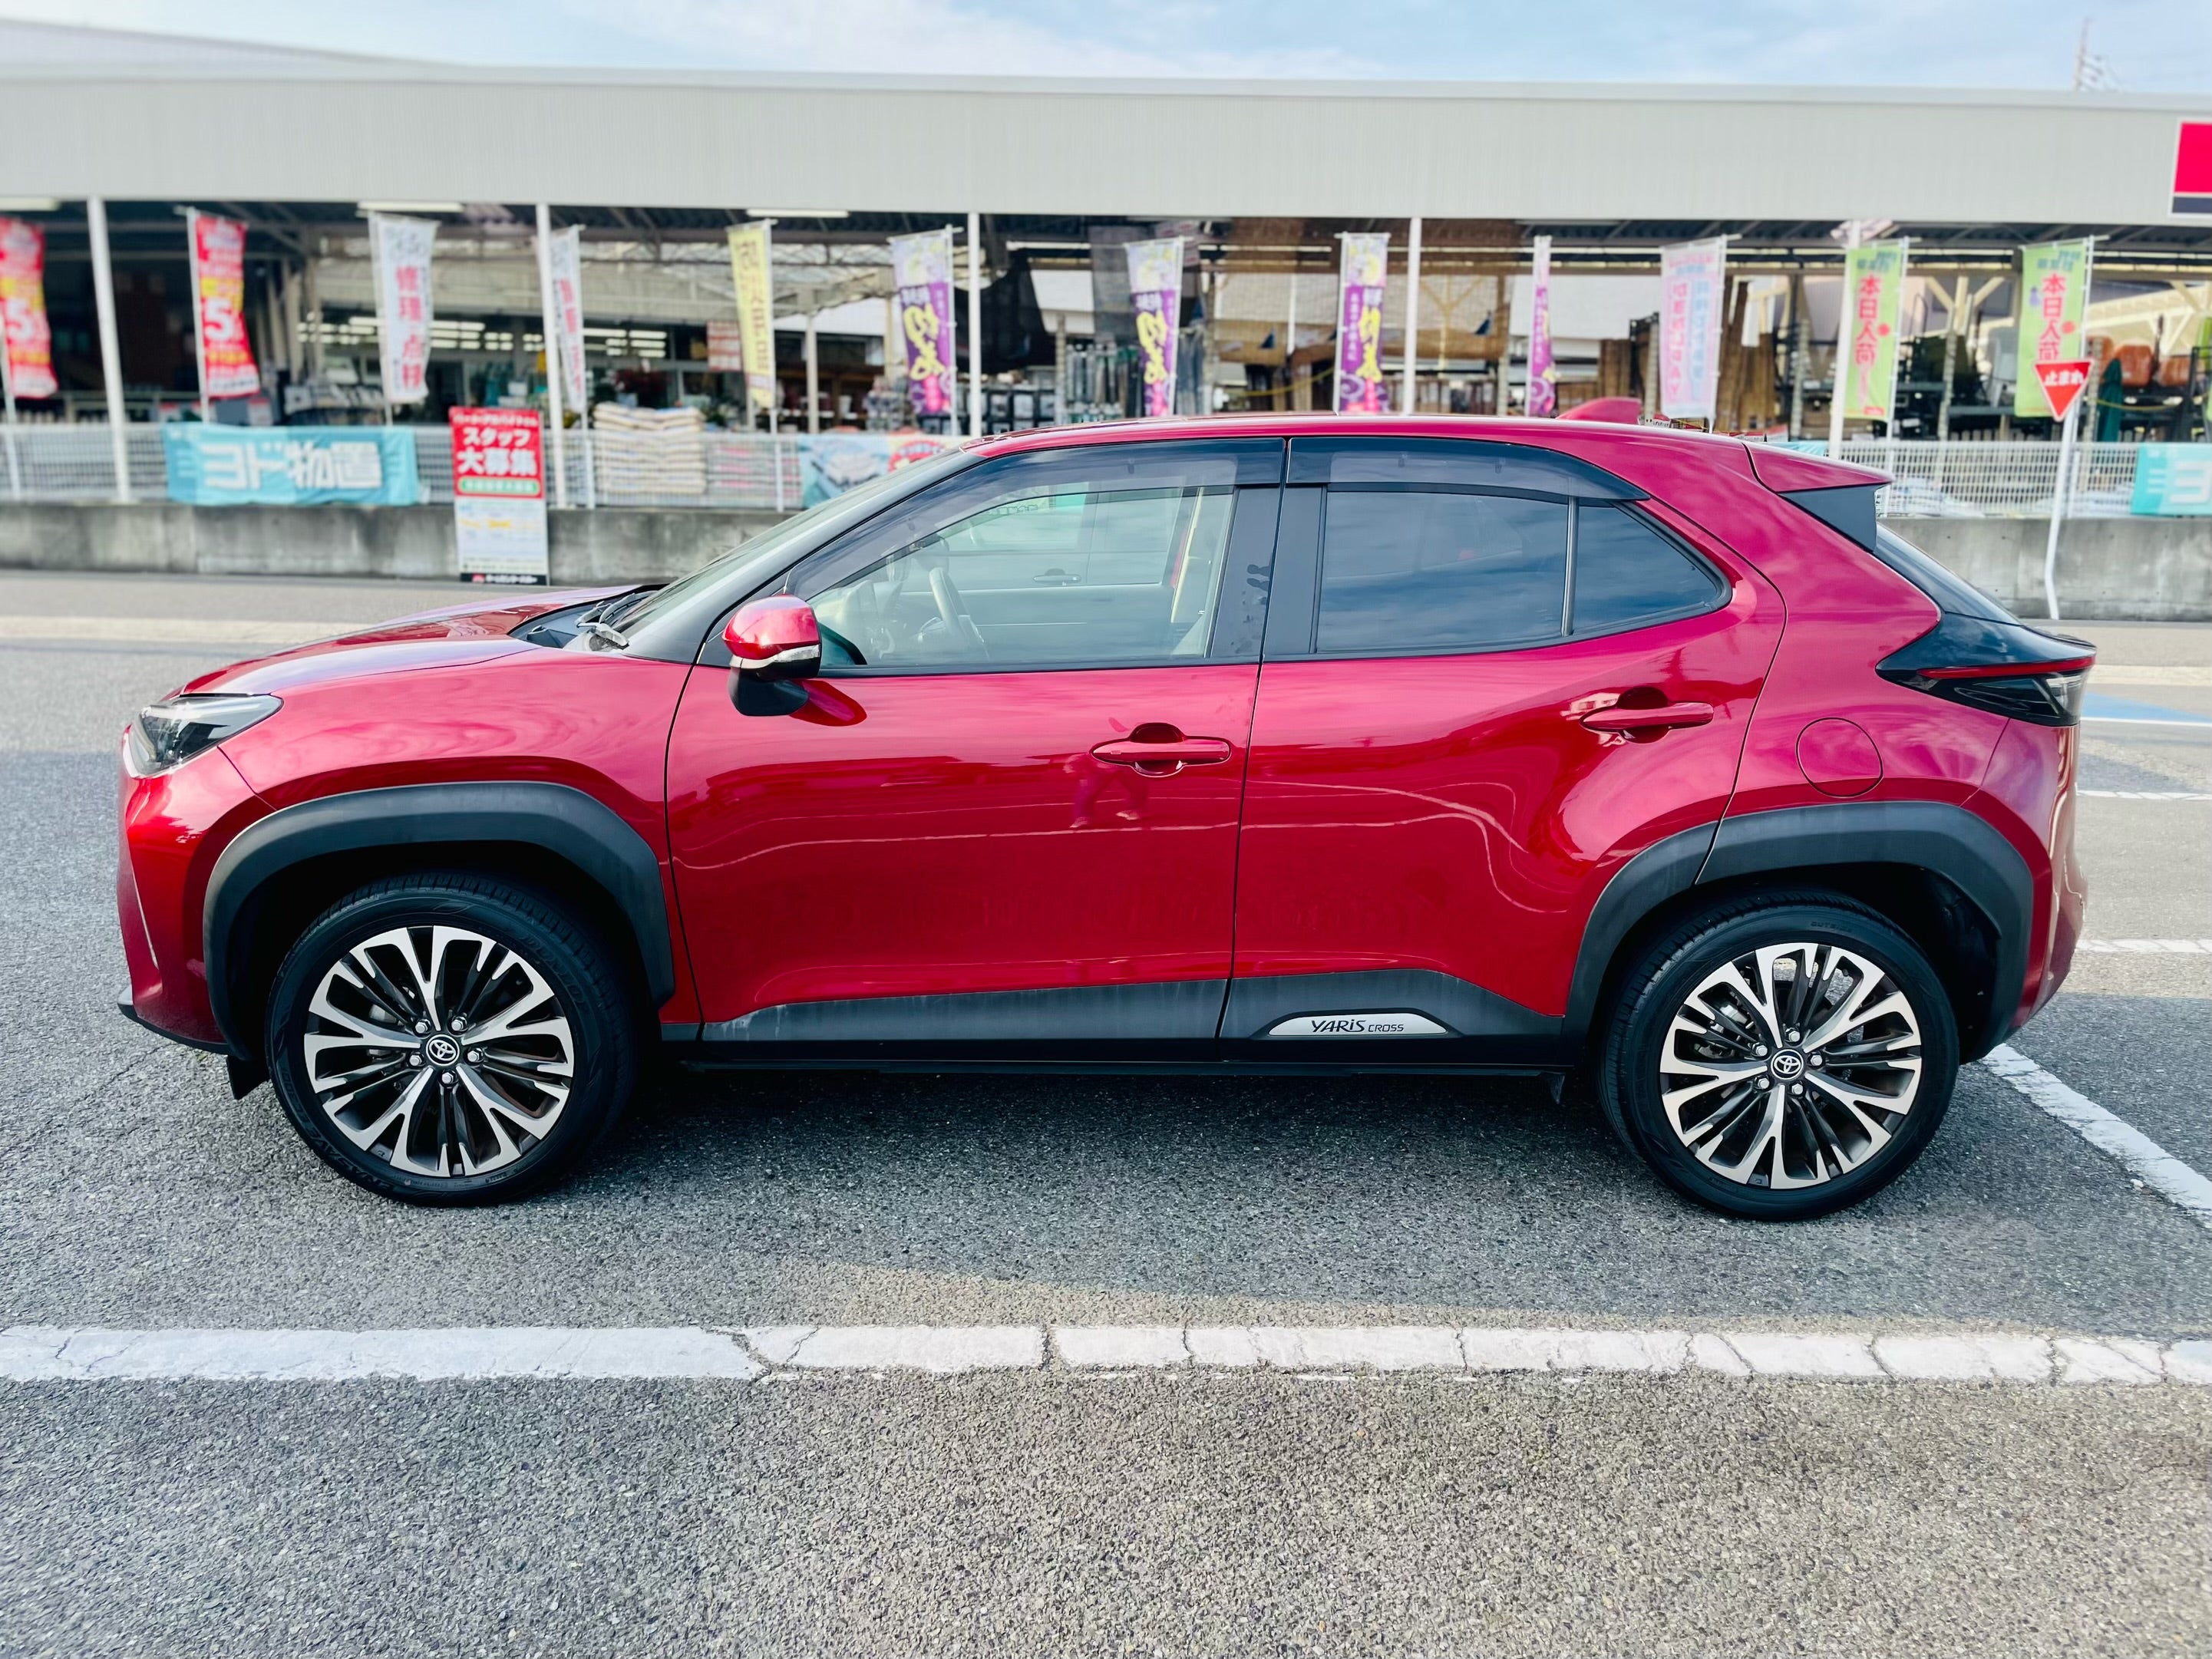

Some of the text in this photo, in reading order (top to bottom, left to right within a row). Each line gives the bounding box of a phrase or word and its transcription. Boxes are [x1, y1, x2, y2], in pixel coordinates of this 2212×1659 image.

[2044, 369, 2085, 387] 止まれ
[463, 427, 532, 447] スタッフ
[200, 440, 382, 490] ヨド物置
[457, 446, 537, 477] 大募集
[1368, 1024, 1405, 1032] CROSS
